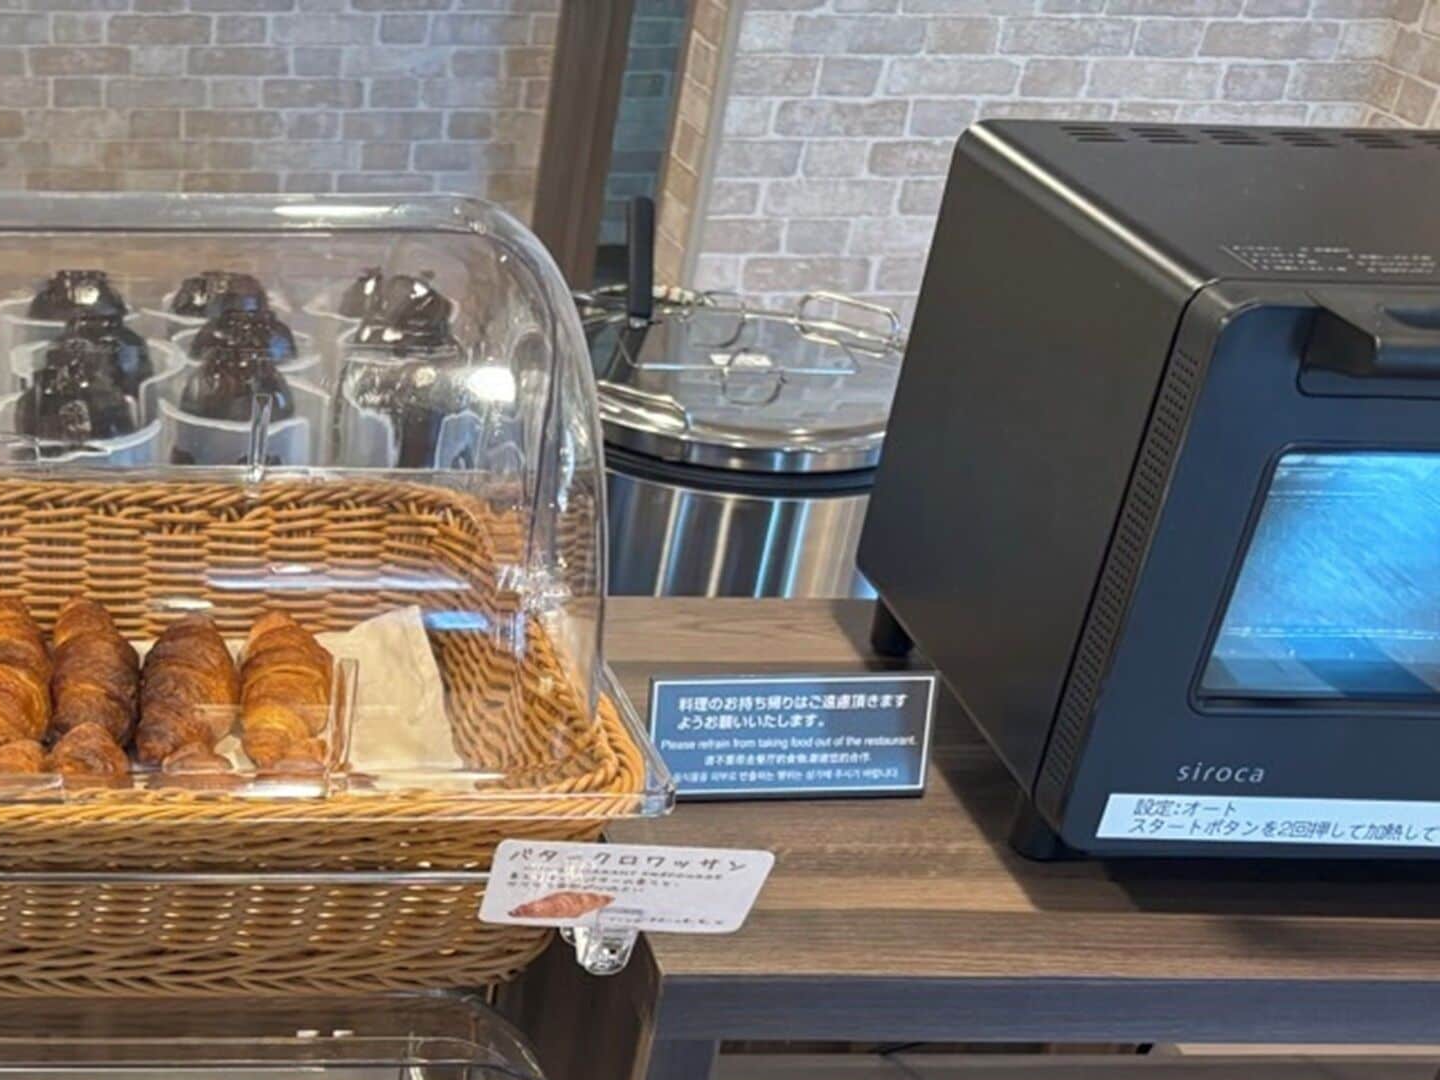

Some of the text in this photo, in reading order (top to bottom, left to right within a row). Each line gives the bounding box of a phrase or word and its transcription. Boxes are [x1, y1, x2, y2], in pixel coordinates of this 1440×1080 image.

[733, 738, 756, 749] from
[758, 738, 788, 750] taking
[790, 736, 813, 748] food
[814, 736, 832, 747] out
[845, 735, 862, 747] the
[1176, 762, 1266, 783] siroca
[510, 848, 747, 871] バタークロワッサン
